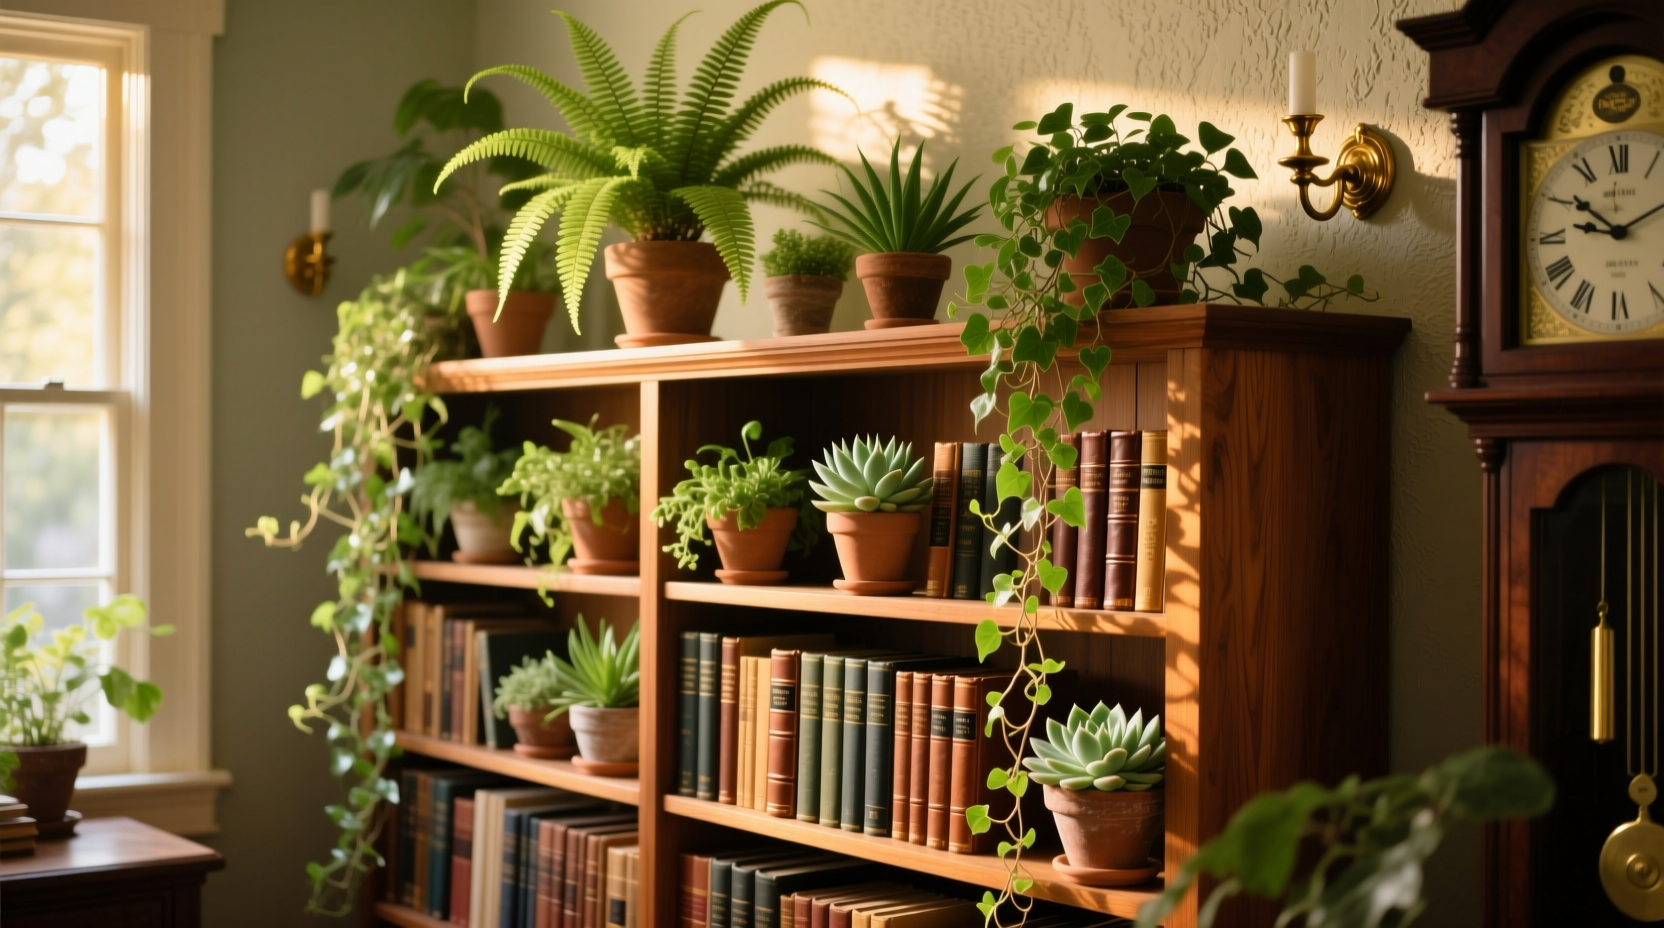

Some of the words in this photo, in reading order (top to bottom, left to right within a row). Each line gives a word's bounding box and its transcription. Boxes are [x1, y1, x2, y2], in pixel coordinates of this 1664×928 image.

[1571, 157, 1597, 188] XI
[1608, 144, 1628, 175] XII
[1611, 290, 1629, 321] VI
